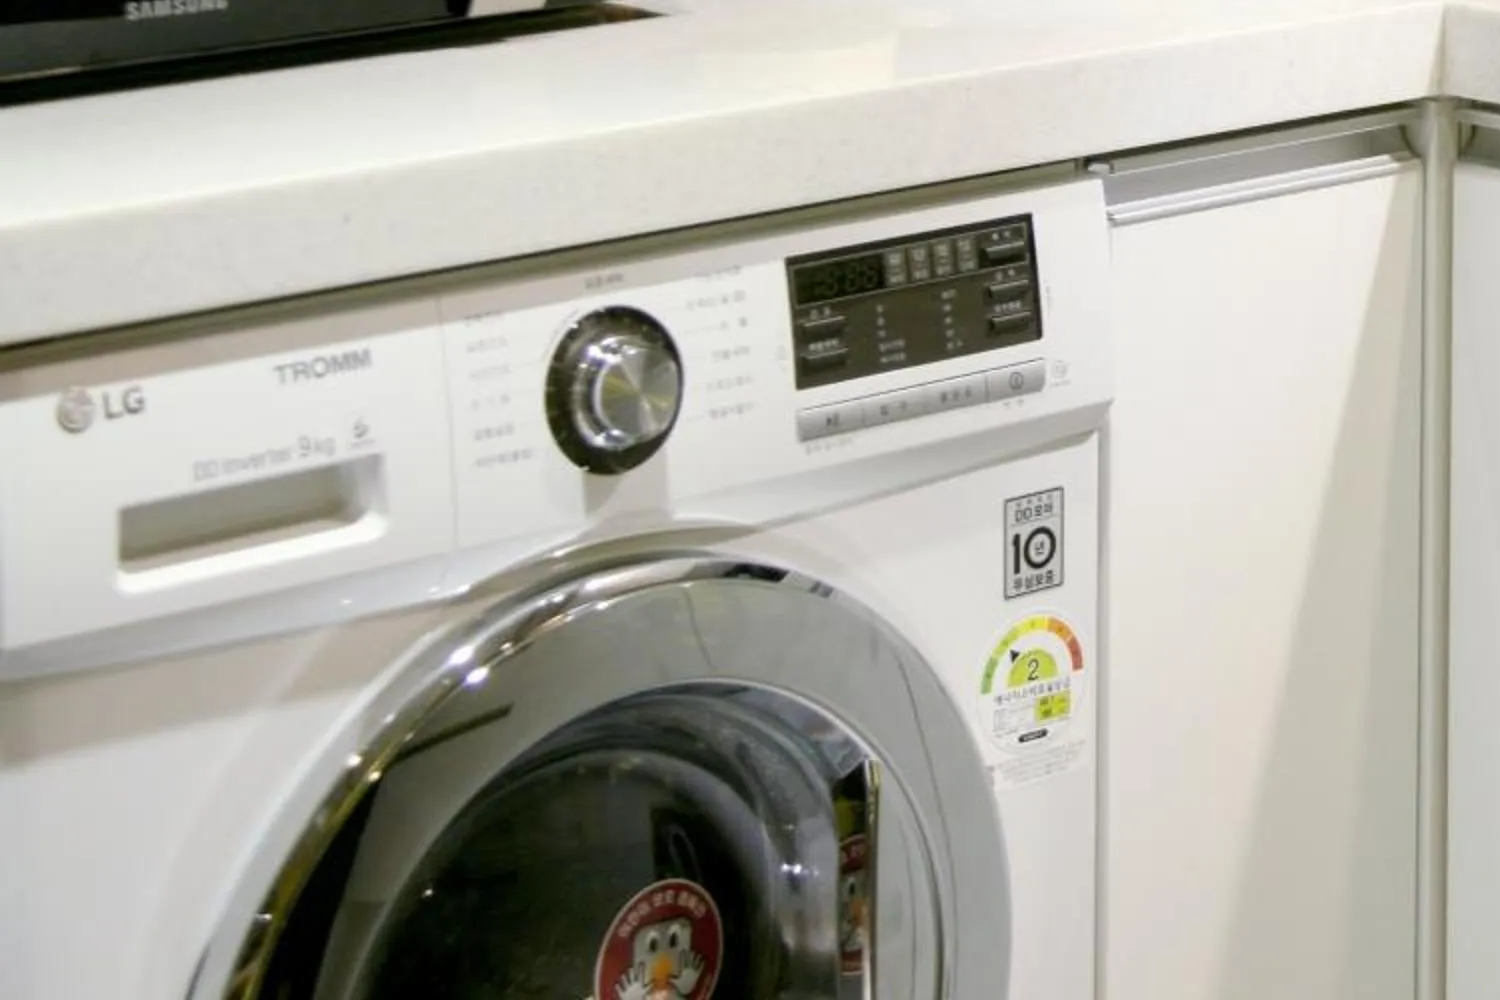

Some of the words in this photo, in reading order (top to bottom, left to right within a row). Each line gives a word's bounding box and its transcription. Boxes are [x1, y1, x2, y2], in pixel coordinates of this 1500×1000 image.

[274, 348, 372, 387] TROMM
[102, 386, 145, 421] LG
[1012, 526, 1057, 575] 10
[1026, 658, 1039, 681] 2
